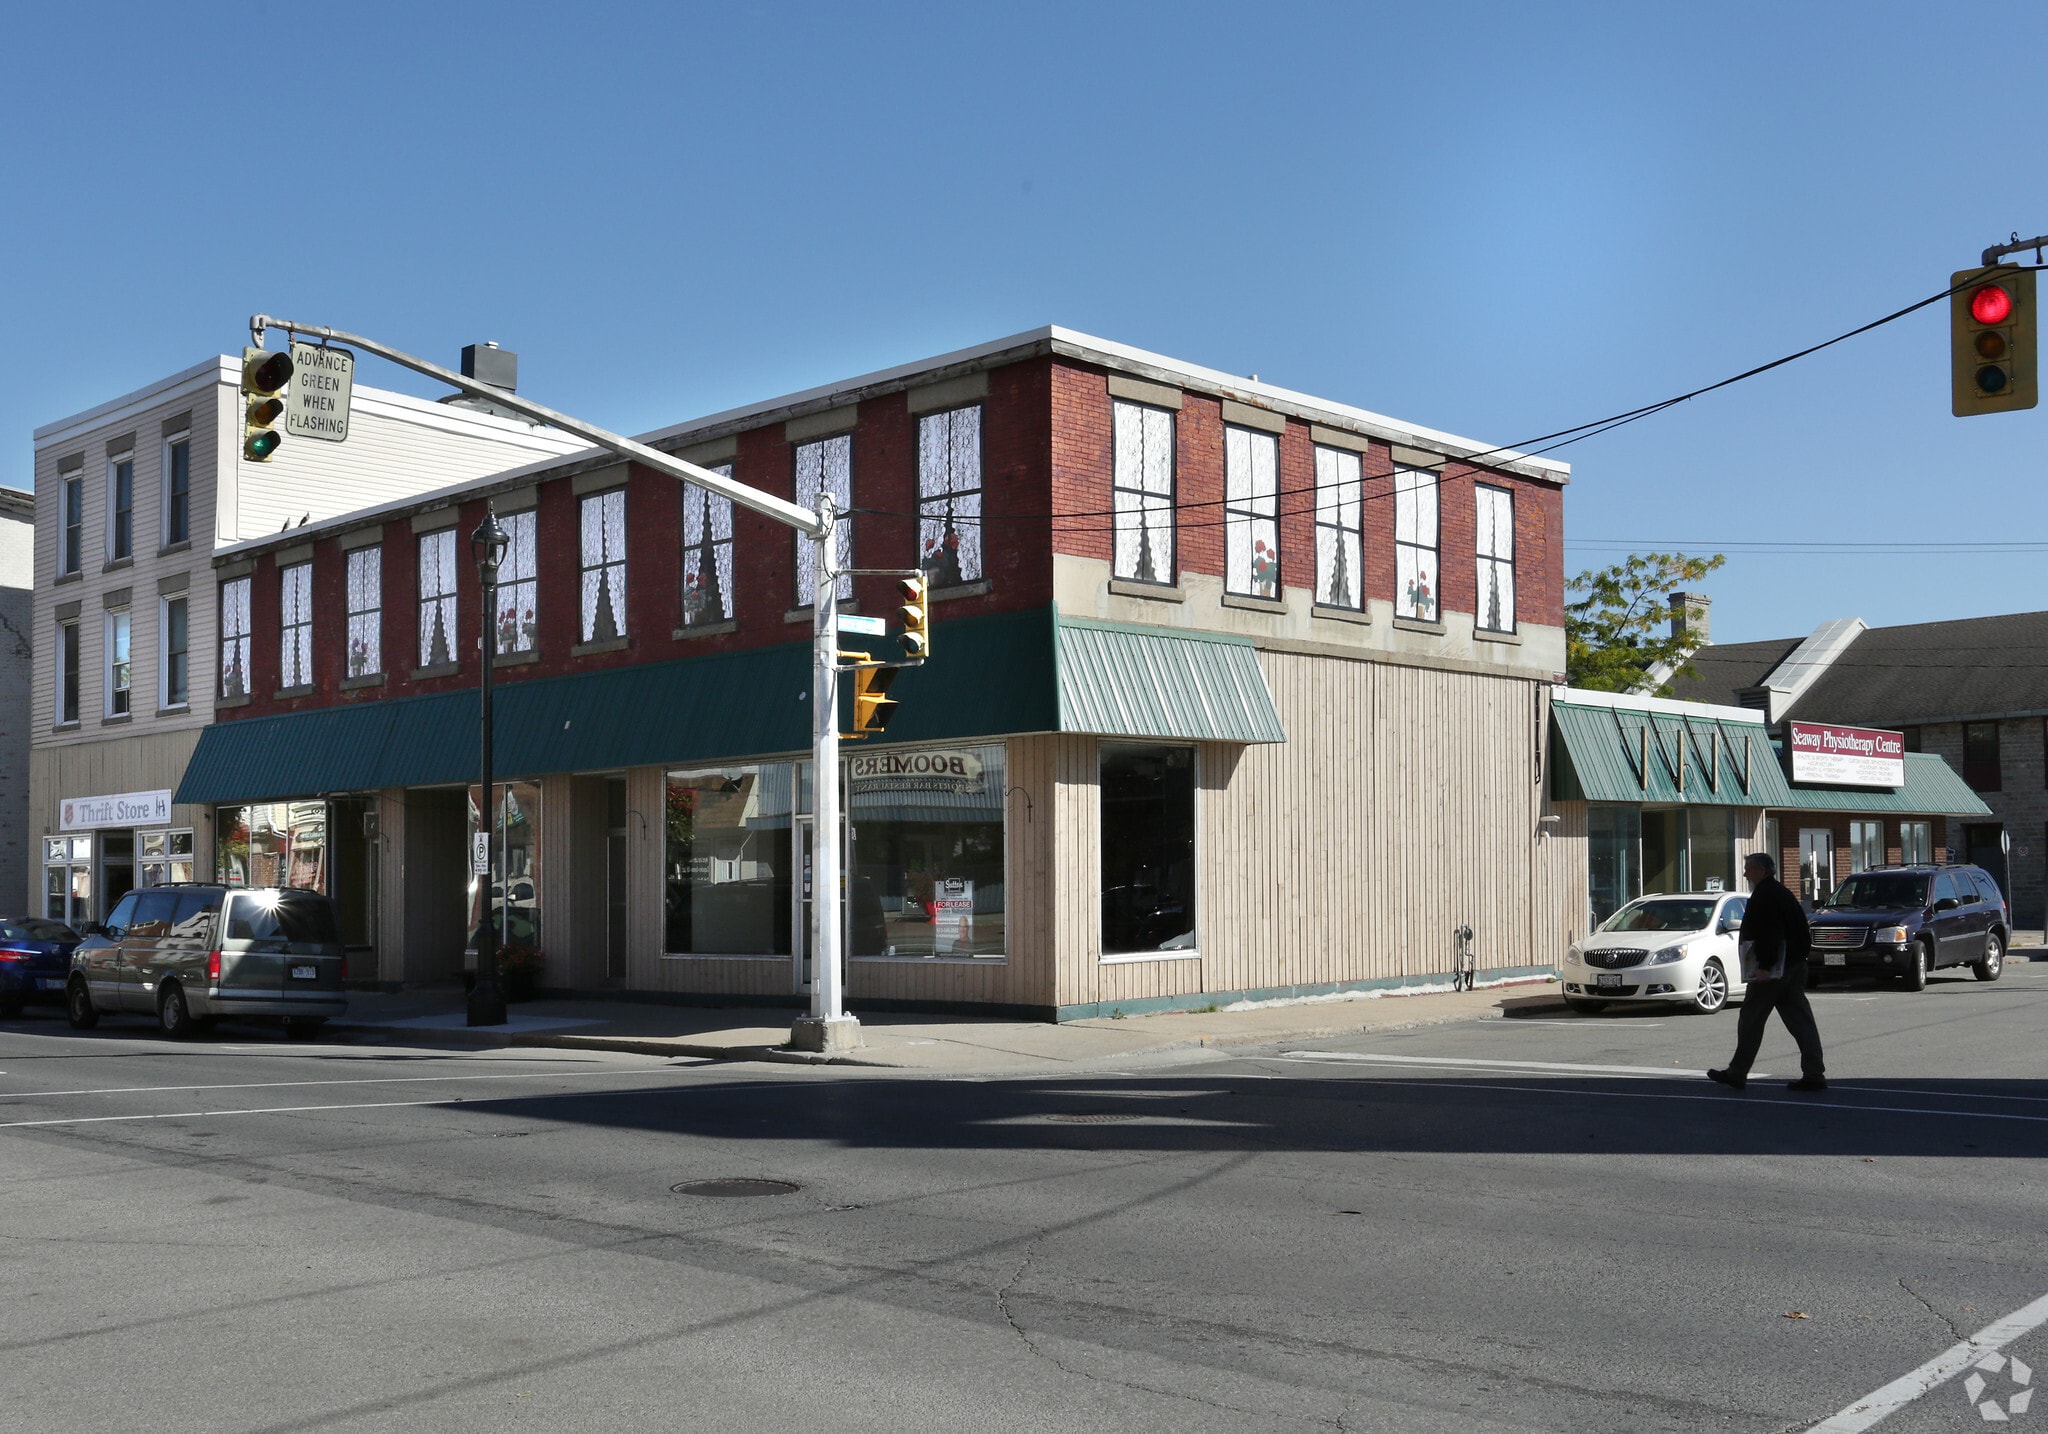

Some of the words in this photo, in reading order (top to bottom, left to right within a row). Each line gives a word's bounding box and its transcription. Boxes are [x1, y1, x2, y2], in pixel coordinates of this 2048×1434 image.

[297, 352, 347, 372] ADVANCE
[301, 373, 340, 392] GREEN
[303, 394, 335, 412] WHEN
[290, 414, 344, 434] FLASHING
[1792, 727, 1821, 751] Seaway
[1823, 731, 1874, 755] Physiotherapy
[1876, 736, 1901, 754] Centre
[80, 802, 114, 822] Thrift
[117, 801, 149, 820] Store
